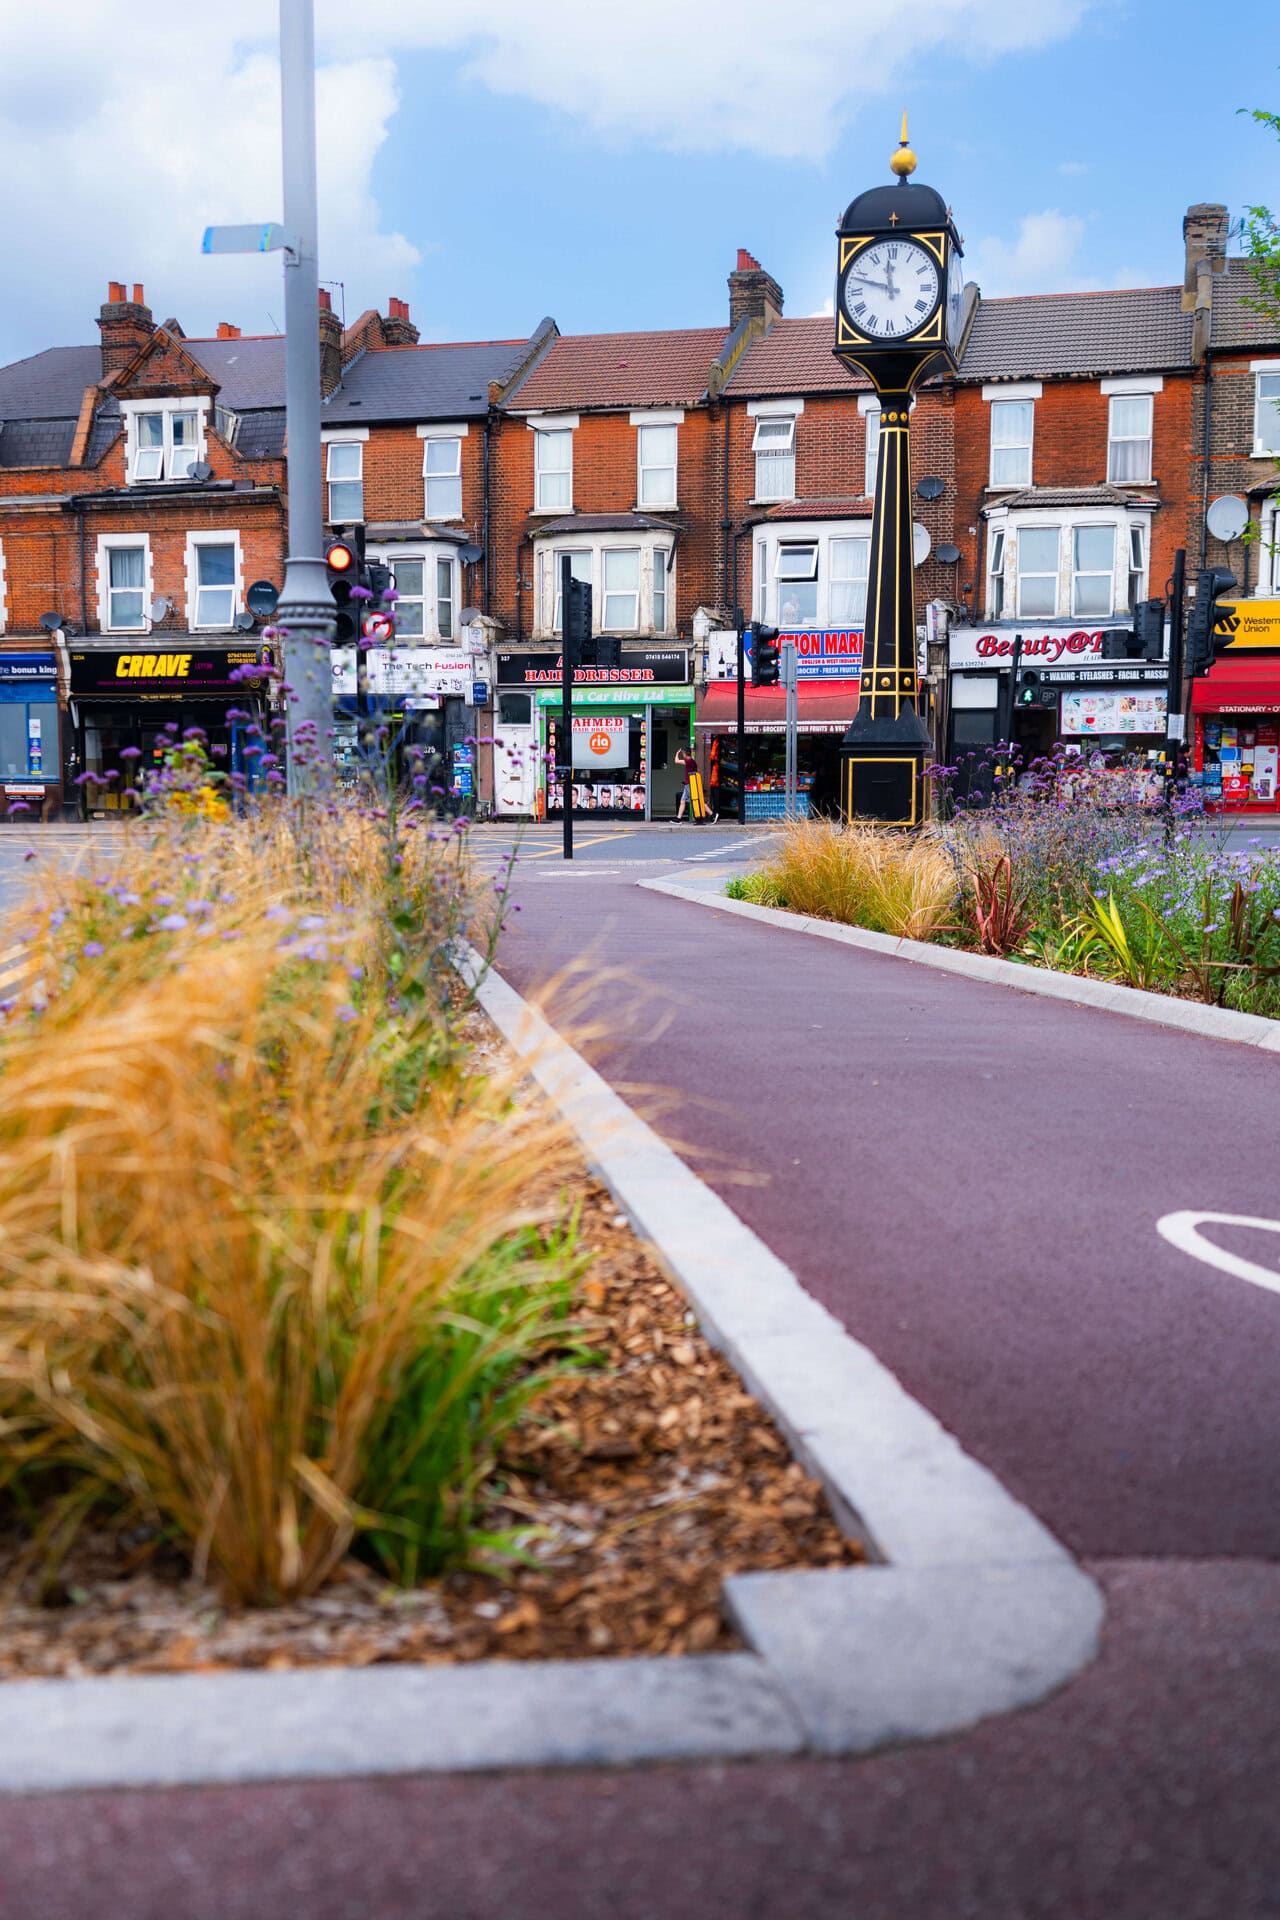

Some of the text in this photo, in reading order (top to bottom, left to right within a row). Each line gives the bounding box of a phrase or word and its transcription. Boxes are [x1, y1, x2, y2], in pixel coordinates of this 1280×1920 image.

[1243, 617, 1280, 625] Western
[11, 665, 37, 674] bonus
[39, 665, 57, 675] king
[574, 668, 654, 681] DRESSER
[1049, 672, 1075, 681] WAXING
[1080, 671, 1114, 681] EYELASHES
[1118, 670, 1140, 680] FACIAL
[1144, 670, 1169, 679] MASSA
[588, 692, 609, 702] Car
[643, 688, 664, 701] Ltd
[573, 718, 623, 727] AHMED
[591, 735, 608, 746] ria
